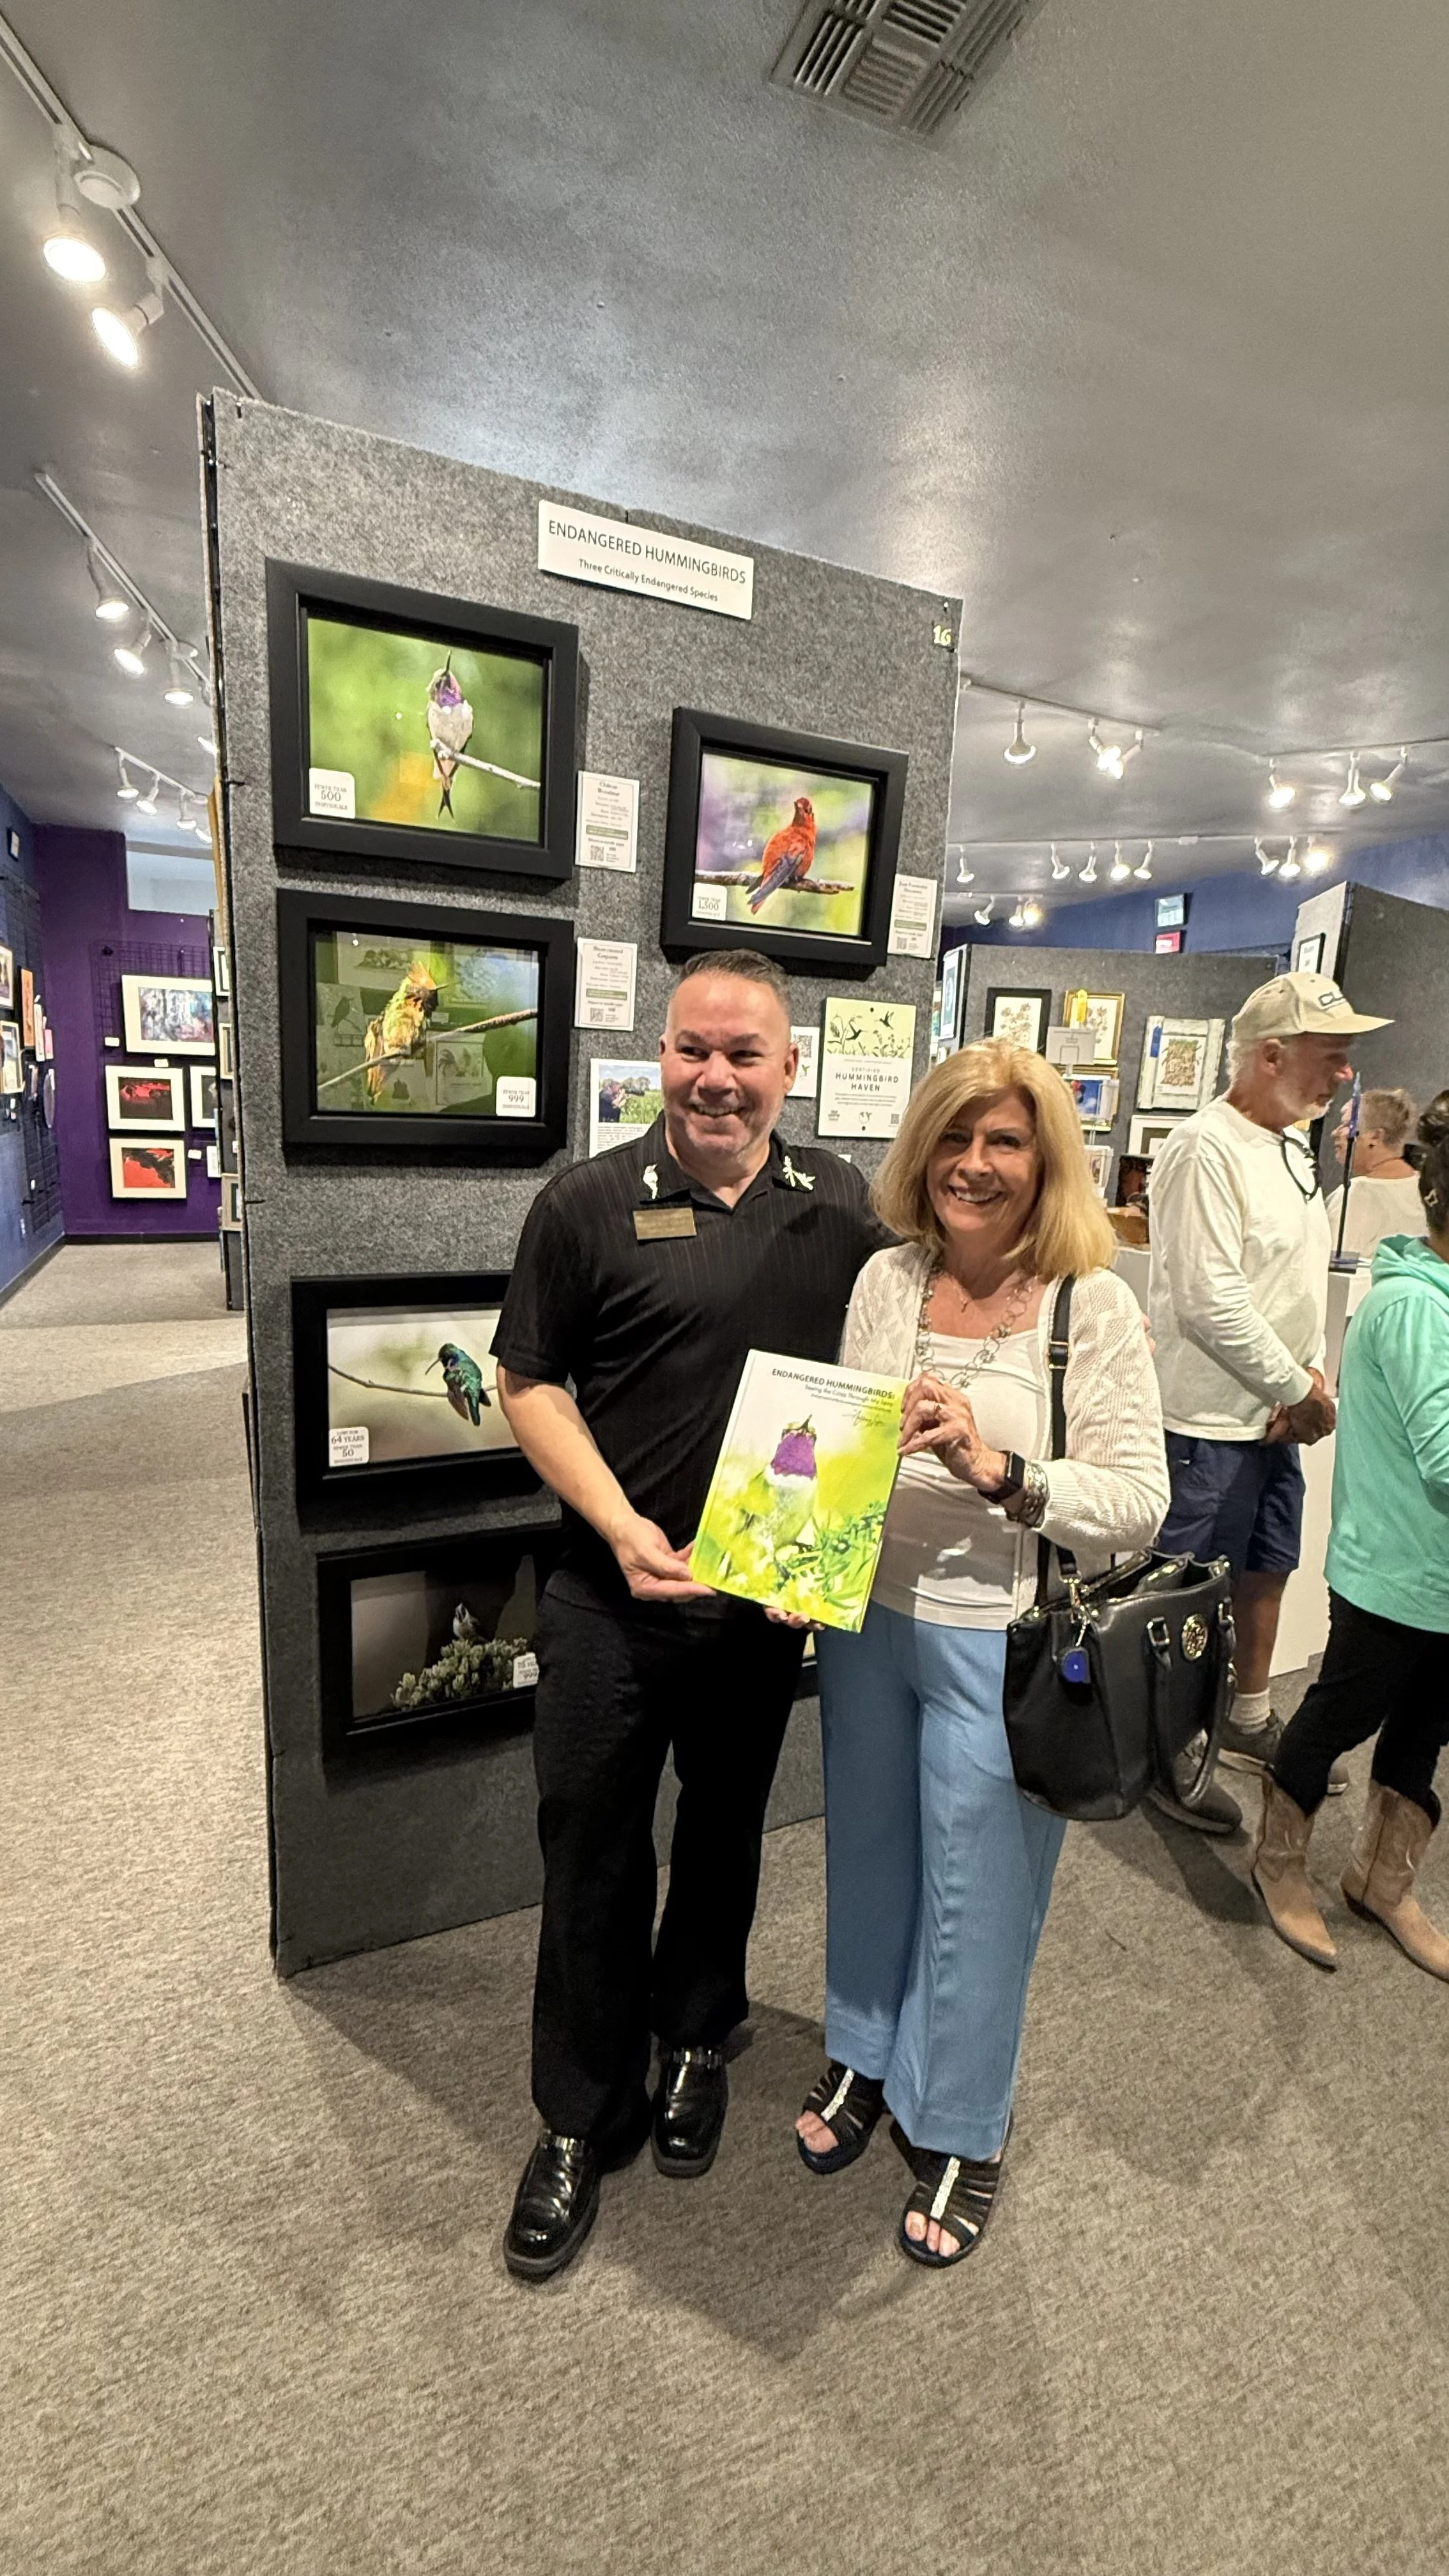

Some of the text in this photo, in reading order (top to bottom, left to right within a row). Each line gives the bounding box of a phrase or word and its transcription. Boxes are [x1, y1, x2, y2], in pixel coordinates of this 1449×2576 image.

[548, 519, 746, 585] ENDANGERED HUMMINGBIRDS
[578, 558, 719, 603] Three Critically Endangered Species
[933, 625, 951, 646] 16
[321, 790, 341, 802] 500
[835, 1071, 899, 1084] HUMMINGBIRD
[850, 1083, 880, 1092] HAVEN
[508, 1094, 525, 1103] 999
[772, 1368, 825, 1386] ENDANGERED
[331, 1434, 365, 1445] 64 YEARS
[342, 1448, 355, 1457] 50
